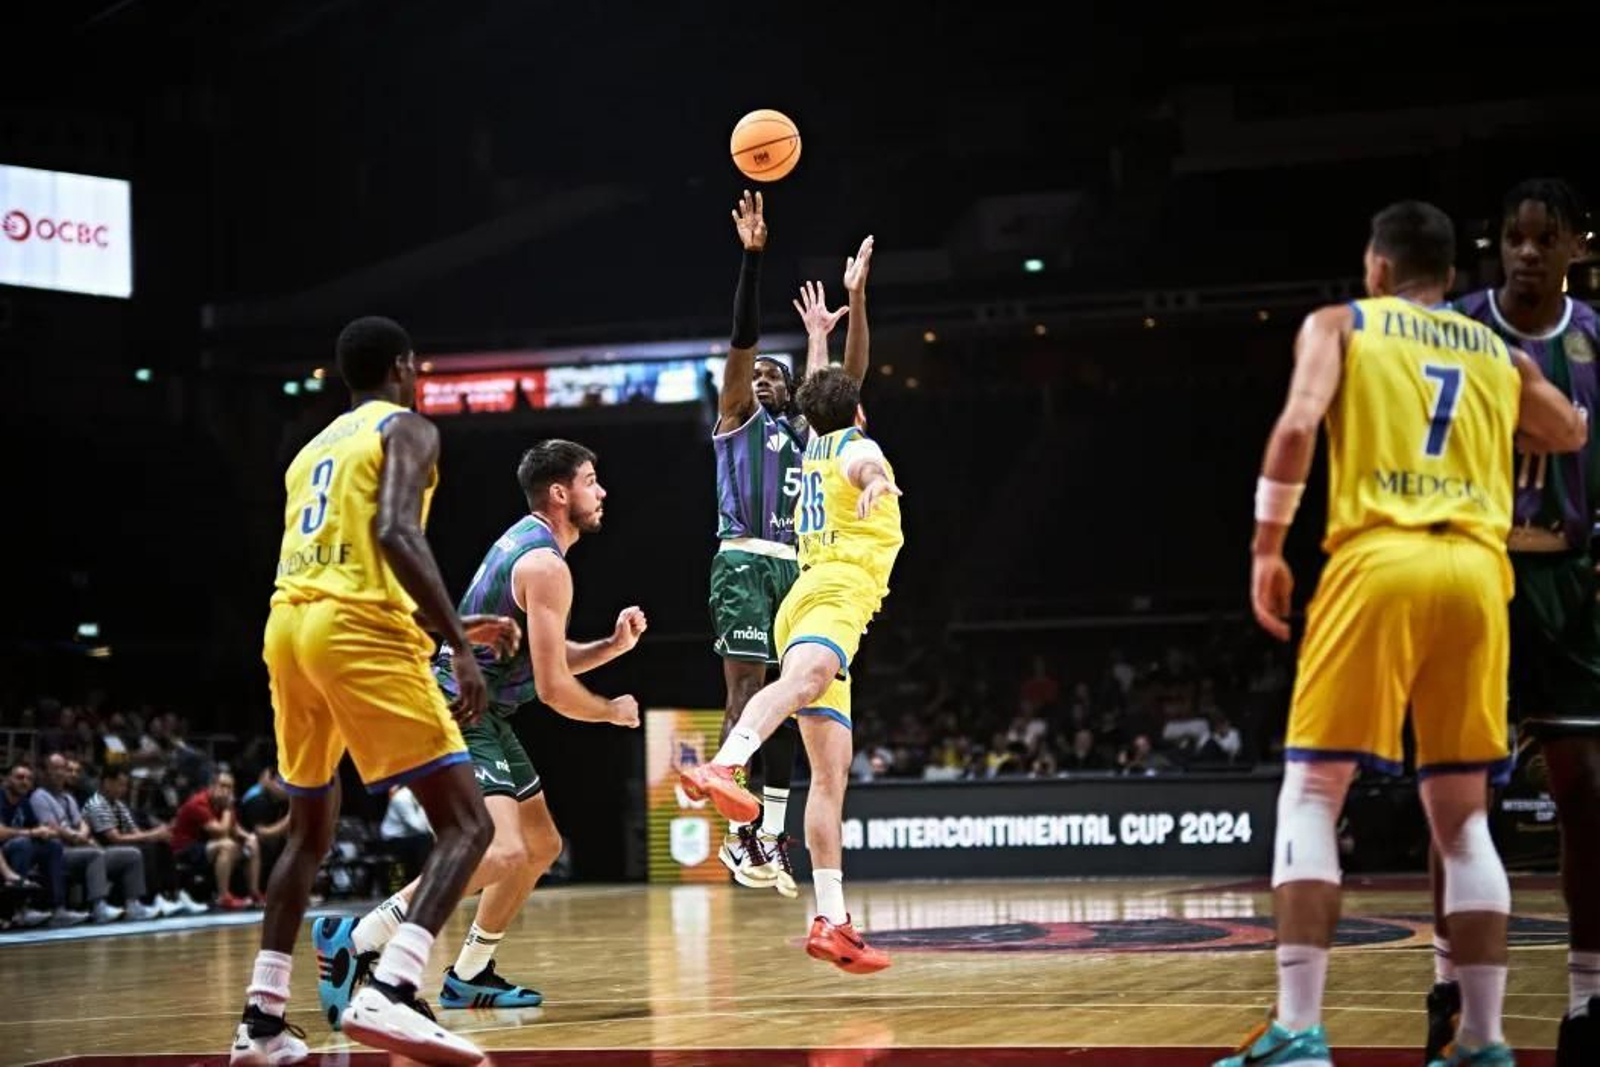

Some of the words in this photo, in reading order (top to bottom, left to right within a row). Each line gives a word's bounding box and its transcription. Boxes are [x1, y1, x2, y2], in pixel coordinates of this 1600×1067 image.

[36, 218, 109, 248] OCBC
[1424, 363, 1462, 457] 7
[300, 458, 335, 536] 3
[782, 467, 802, 496] 5
[799, 470, 826, 533] 16
[867, 813, 1116, 849] INTERCONTINENTAL
[1119, 814, 1175, 844] CUP
[1179, 812, 1252, 844] 2024
